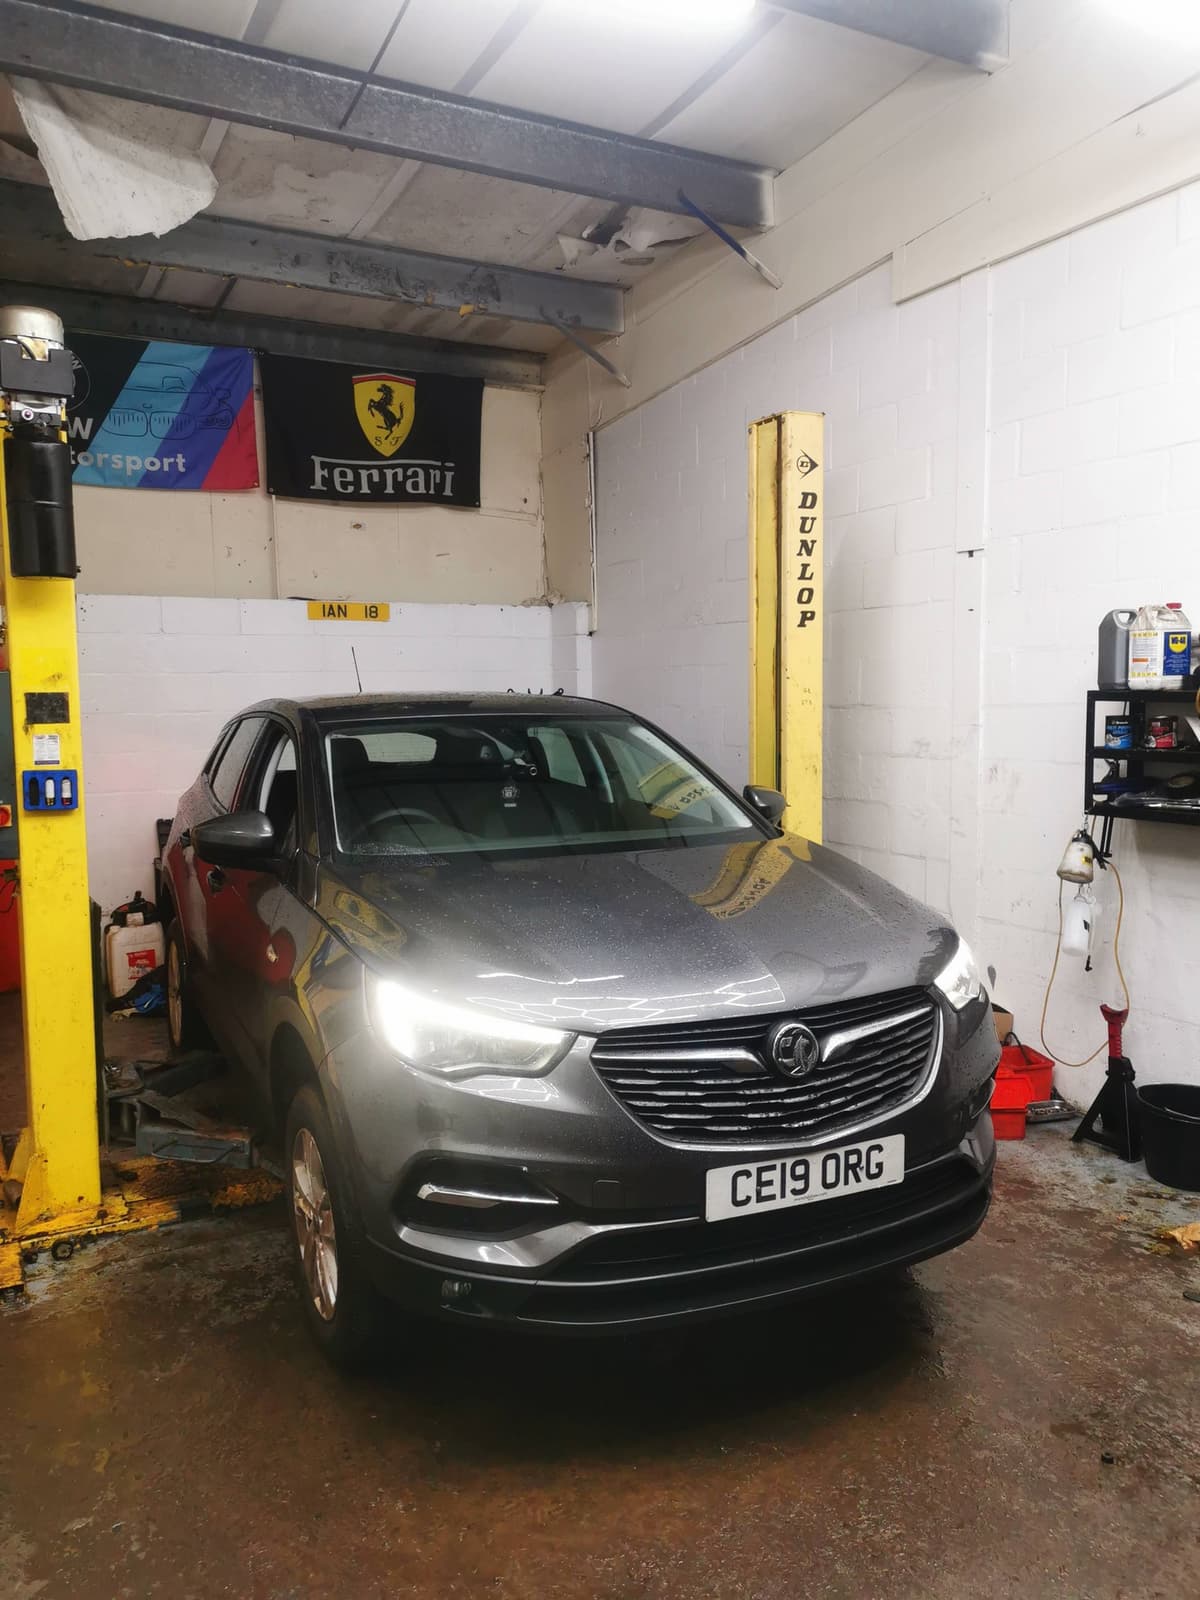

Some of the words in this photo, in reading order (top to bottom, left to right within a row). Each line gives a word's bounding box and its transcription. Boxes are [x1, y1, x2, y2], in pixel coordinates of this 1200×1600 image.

[310, 455, 455, 496] Ferrari
[797, 491, 817, 628] DUNLOP
[364, 605, 379, 619] 18
[731, 1158, 811, 1208] CE19
[821, 1143, 884, 1190] ORG
